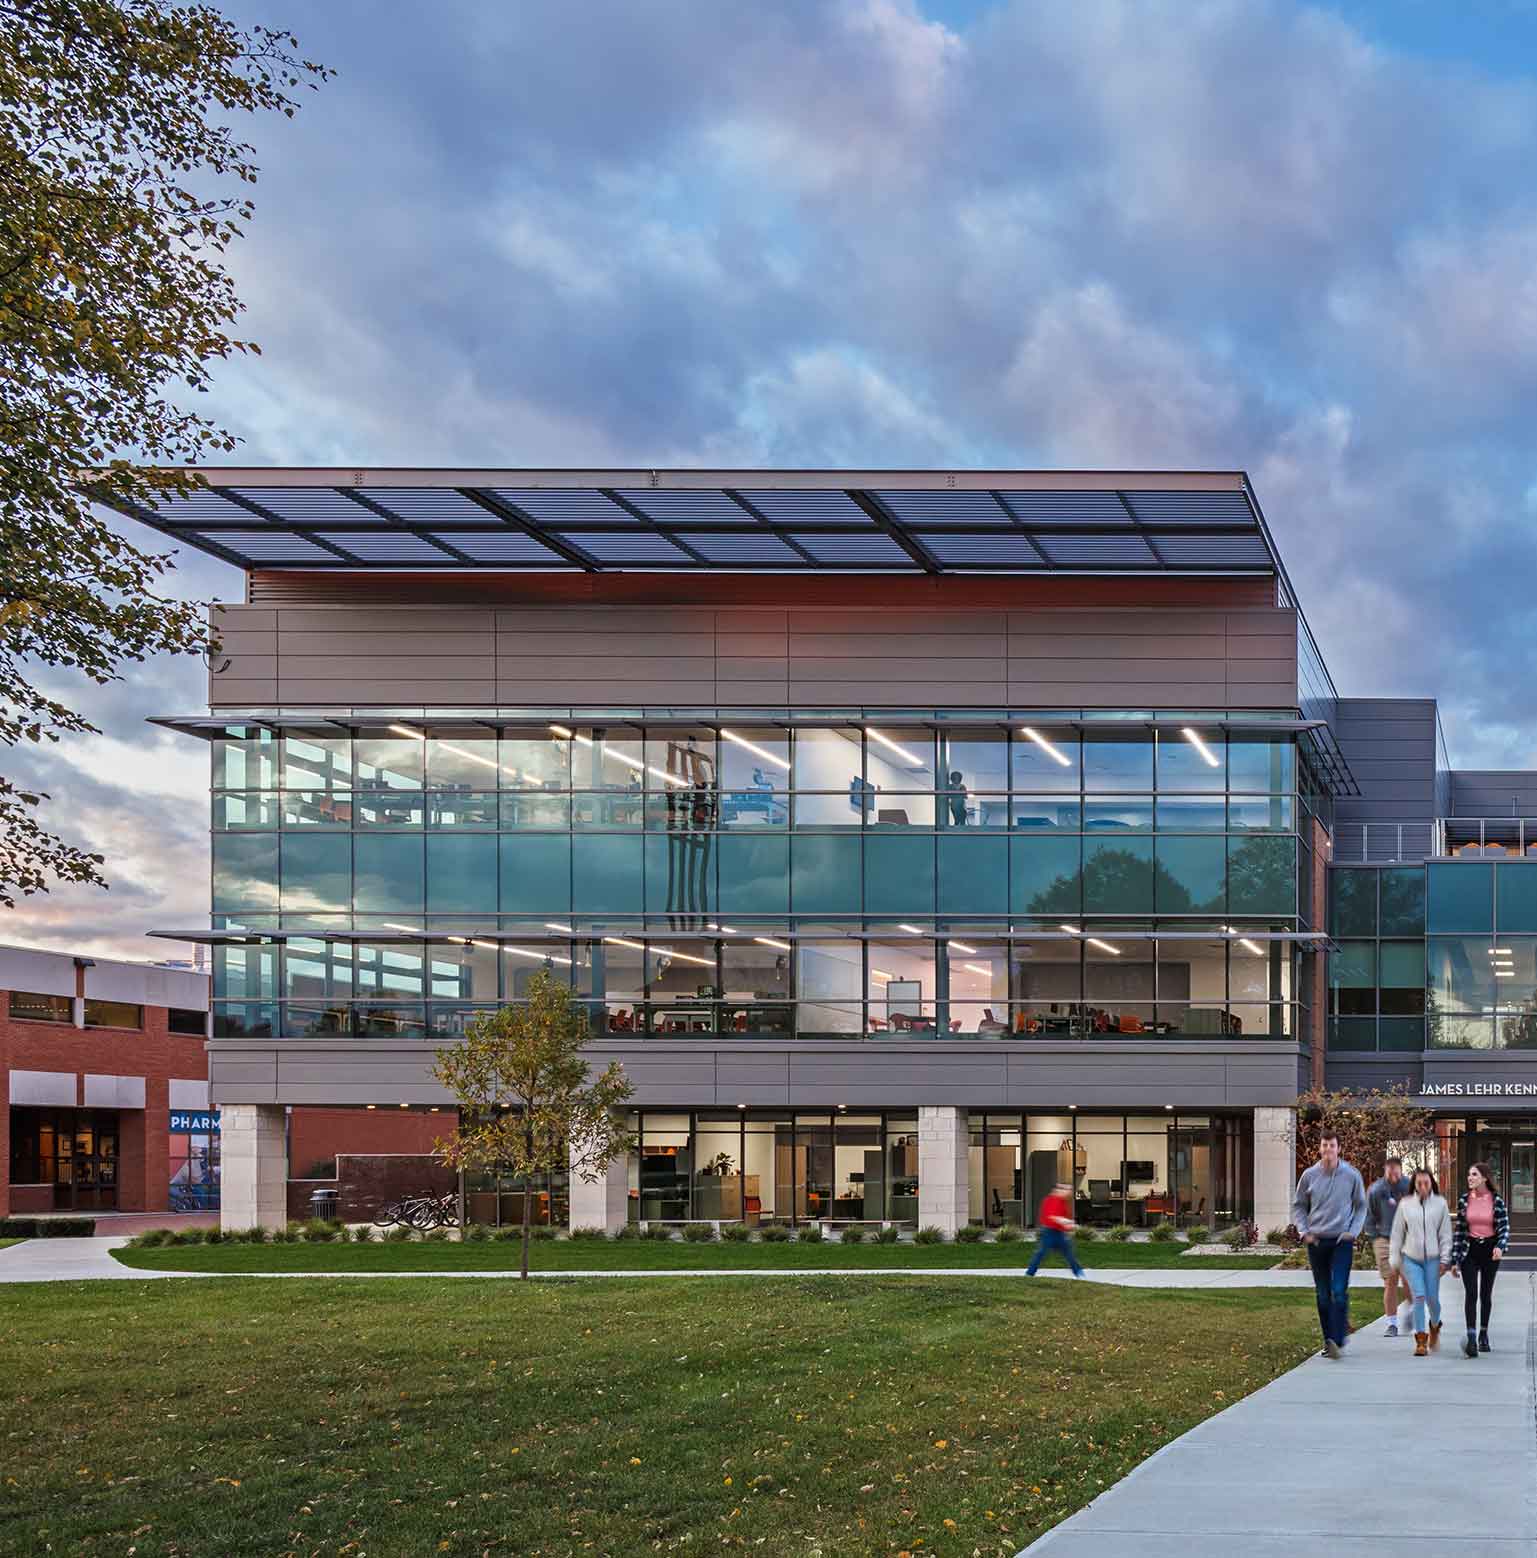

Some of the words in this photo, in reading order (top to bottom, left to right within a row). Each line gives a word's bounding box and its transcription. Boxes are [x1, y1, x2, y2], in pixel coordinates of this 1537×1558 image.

[1419, 1083, 1463, 1095] JAMES
[1466, 1083, 1502, 1095] LEHR
[171, 1116, 222, 1129] PHARM
